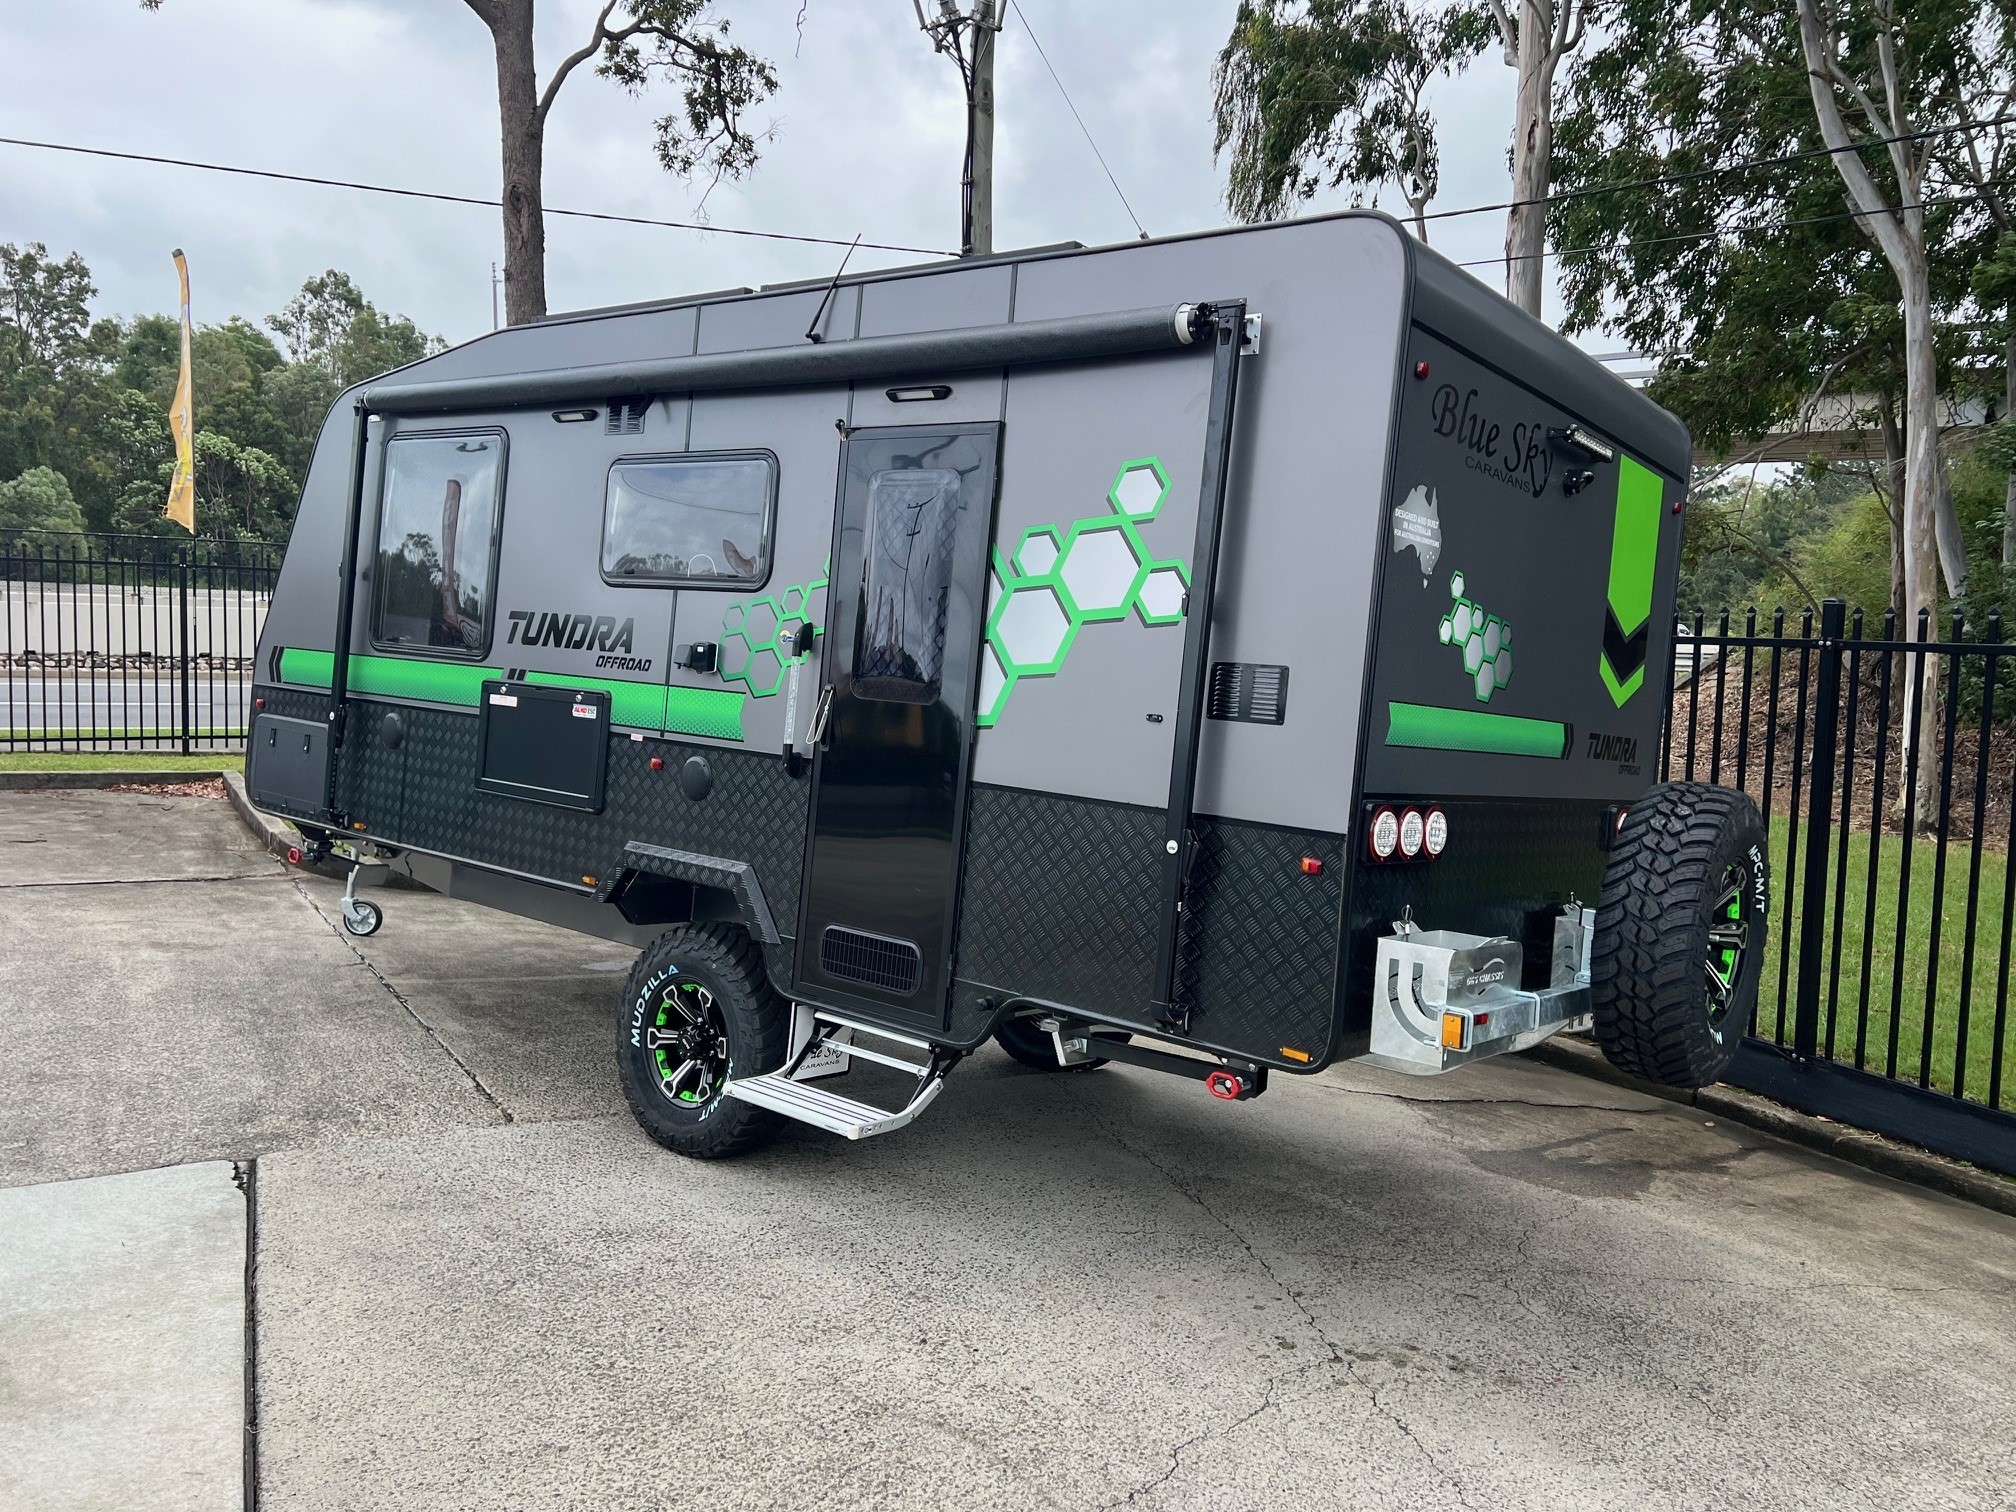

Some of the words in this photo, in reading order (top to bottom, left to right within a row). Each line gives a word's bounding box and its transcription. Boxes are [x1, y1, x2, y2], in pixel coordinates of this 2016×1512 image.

[1432, 383, 1500, 458] Blue
[1504, 422, 1553, 498] Sky
[1465, 455, 1531, 493] CARAVANS
[1395, 508, 1417, 522] DESIGNED
[1417, 515, 1427, 526] AND
[1427, 518, 1439, 529] BUILT
[1403, 520, 1409, 529] IN
[1409, 522, 1432, 537] AUSTRALIA
[507, 610, 635, 654] TUNDRA
[595, 655, 652, 672] OFFROAD
[1587, 732, 1638, 763] TUNDRA
[1618, 764, 1641, 776] OFFROAD
[1747, 844, 1766, 914] MPC-M/T
[630, 964, 680, 1048] MUDZILLA
[800, 1059, 840, 1071] CARAVANS
